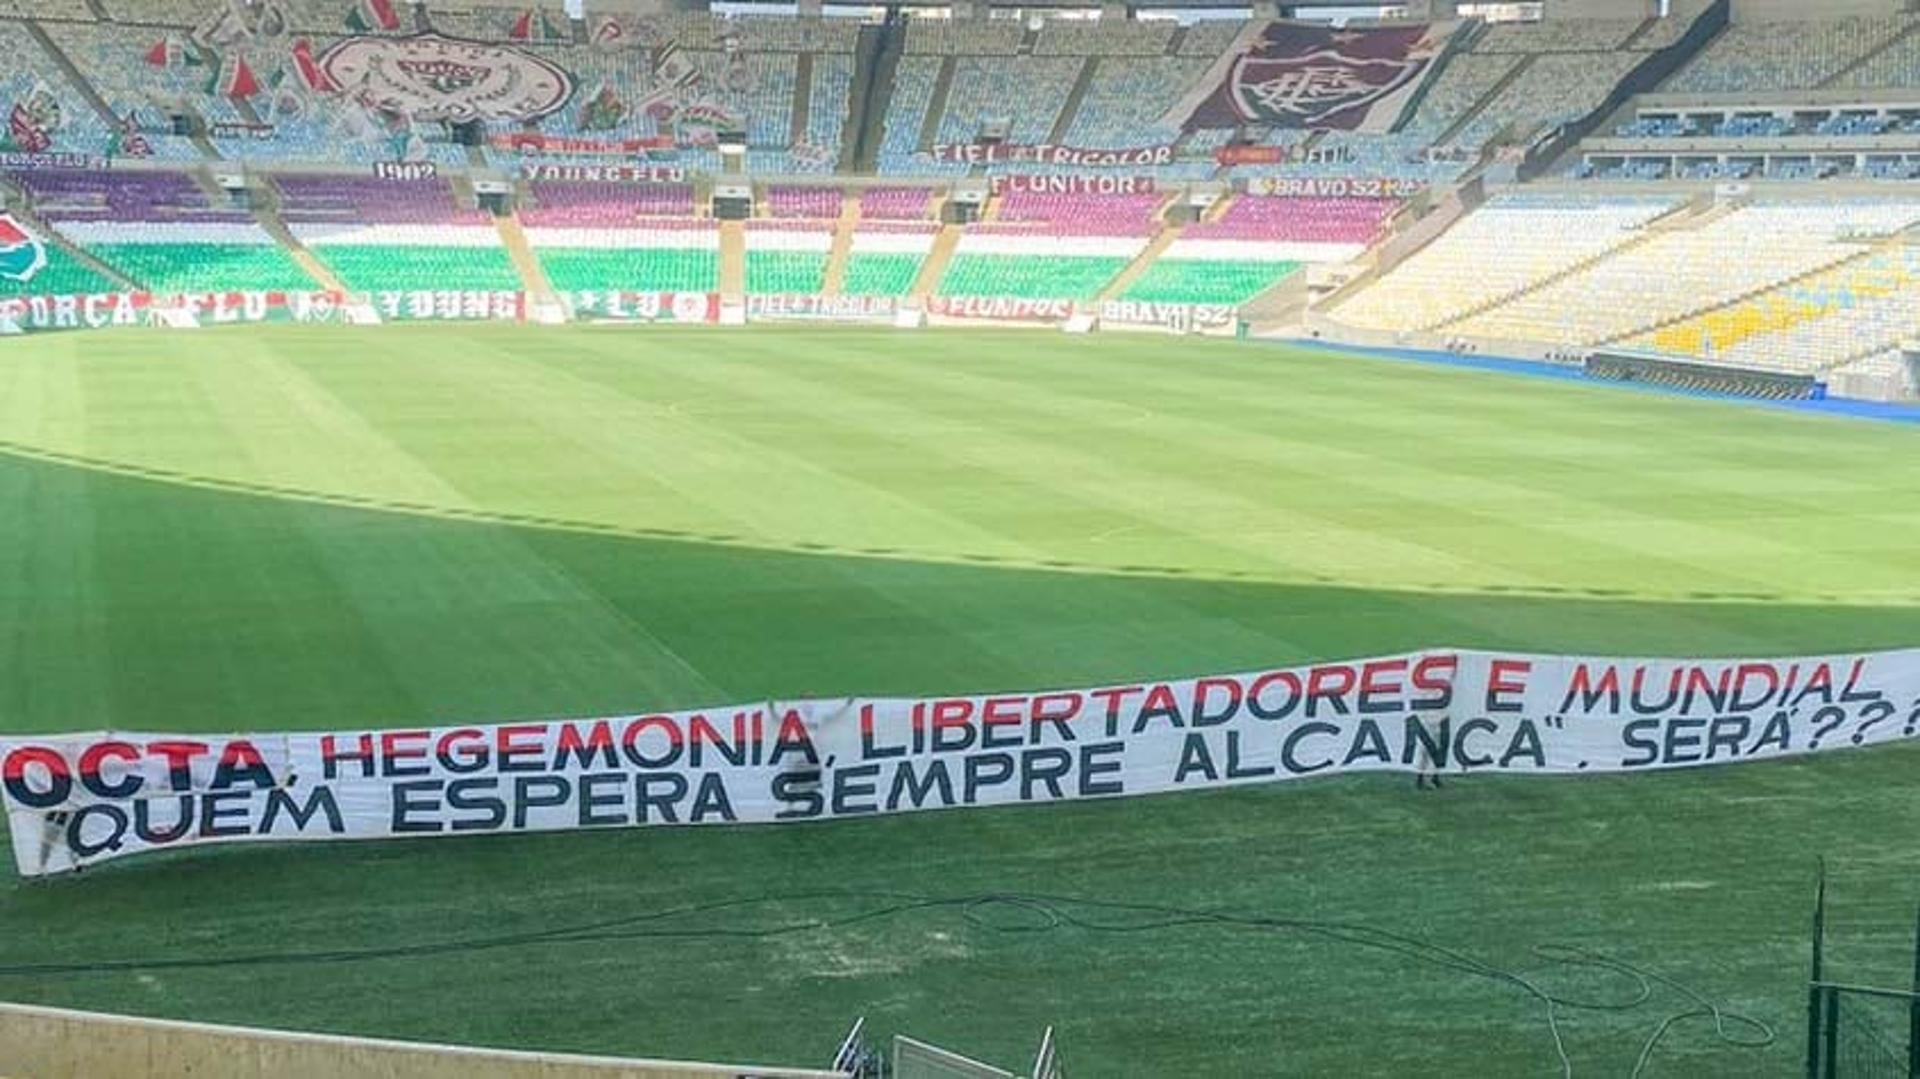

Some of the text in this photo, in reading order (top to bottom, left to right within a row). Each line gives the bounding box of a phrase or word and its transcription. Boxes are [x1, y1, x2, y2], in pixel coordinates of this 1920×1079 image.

[3, 655, 1882, 807] OCTA, HEGEMONIA, LIBERTADORES E MUNDIAL
[391, 771, 738, 832] ESPERA
[771, 740, 1126, 818] SEMPRE
